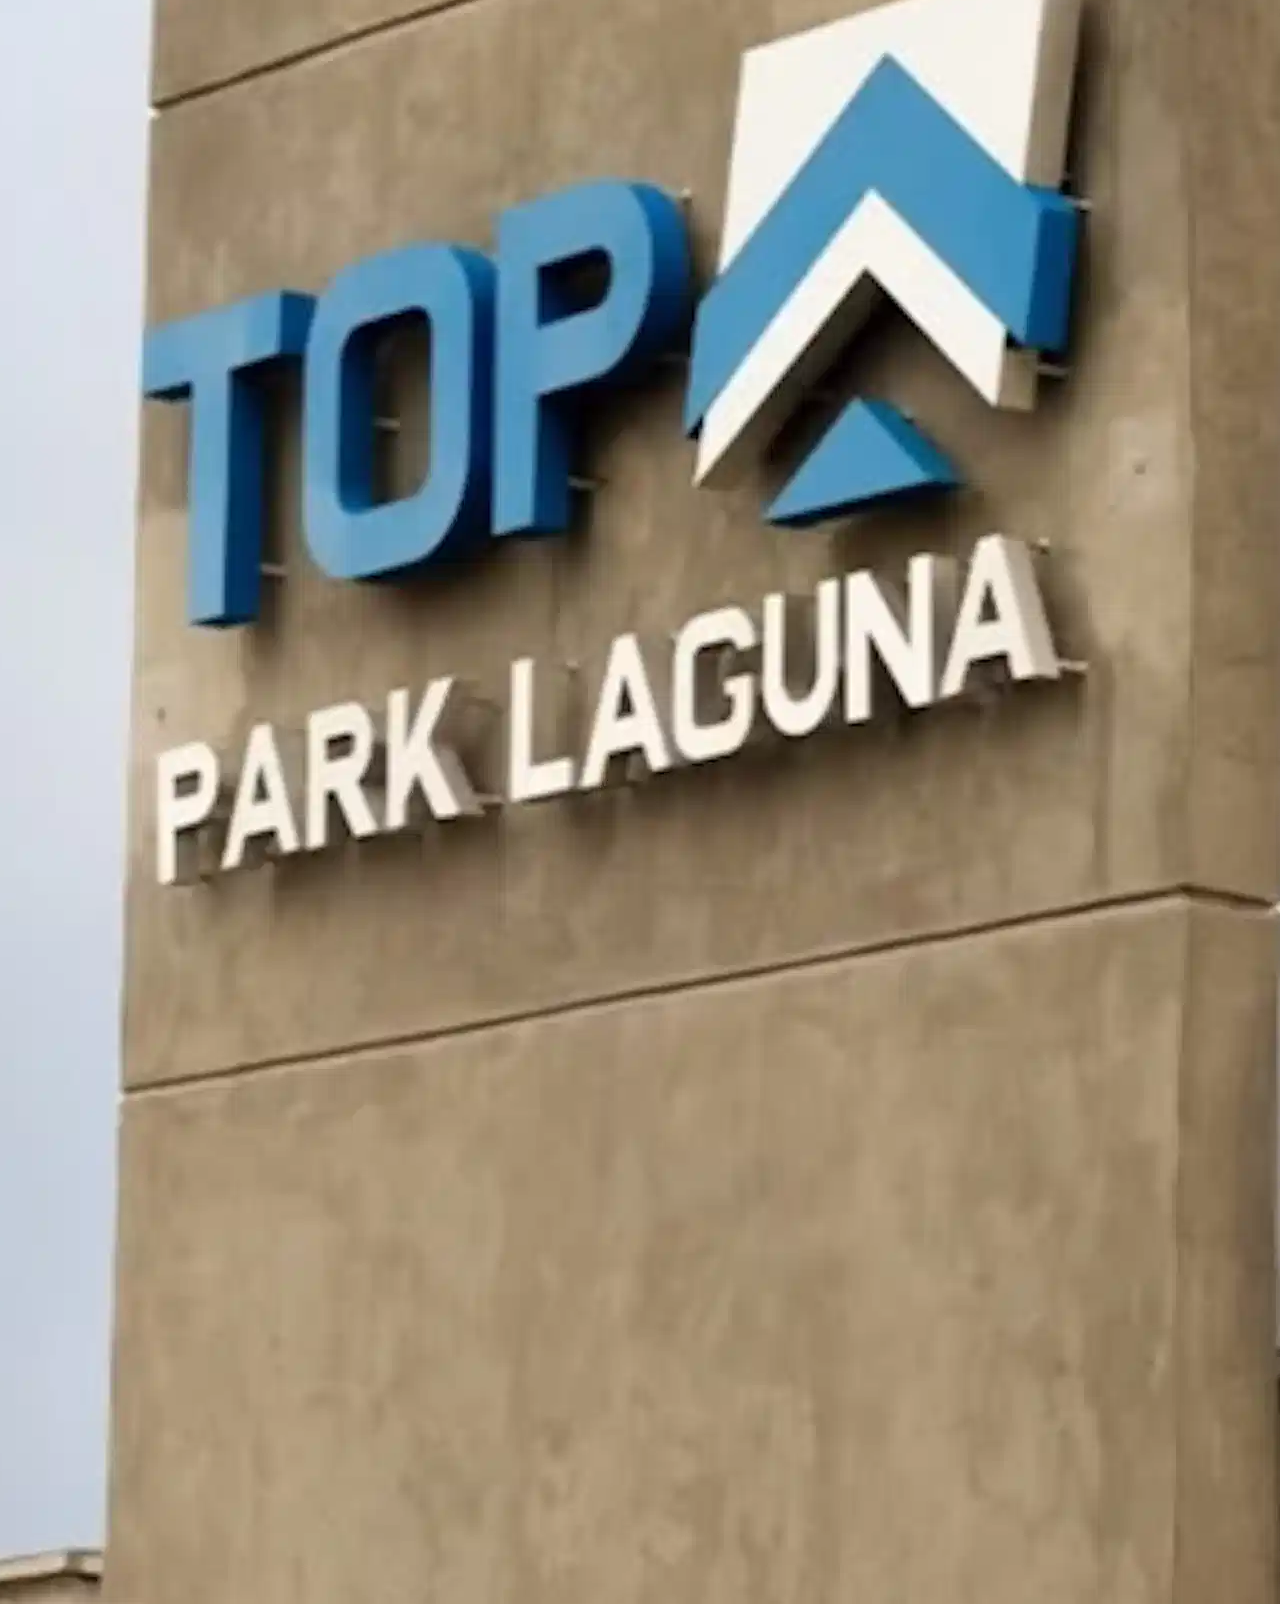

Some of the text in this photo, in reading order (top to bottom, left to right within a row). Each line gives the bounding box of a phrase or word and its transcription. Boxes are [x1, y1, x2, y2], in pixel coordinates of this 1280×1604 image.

[142, 177, 690, 628] TOP
[156, 533, 1058, 884] PARK LAGUNA
